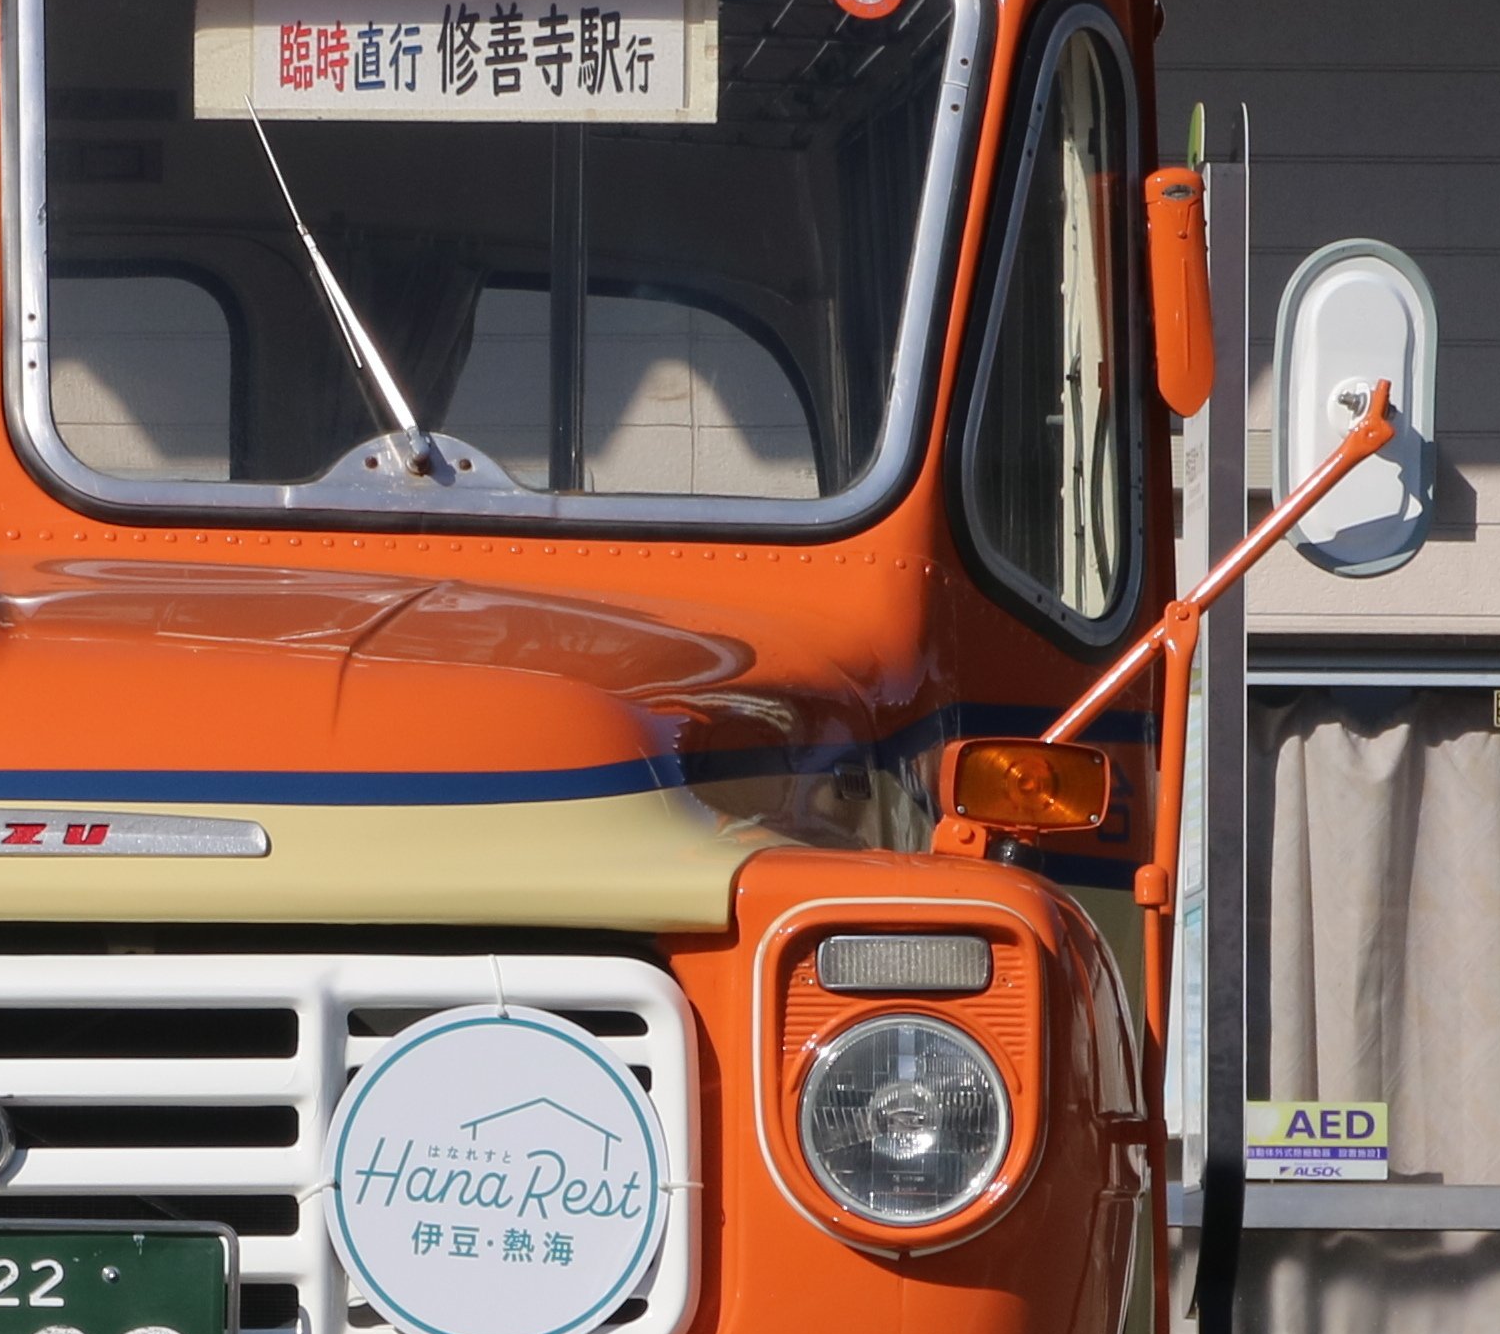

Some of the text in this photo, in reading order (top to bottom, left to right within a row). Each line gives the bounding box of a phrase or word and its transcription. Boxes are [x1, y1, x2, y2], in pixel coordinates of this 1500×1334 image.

[1285, 1110, 1375, 1139] AED
[428, 1144, 513, 1165] はなれすと
[1293, 1166, 1342, 1177] ALSOK
